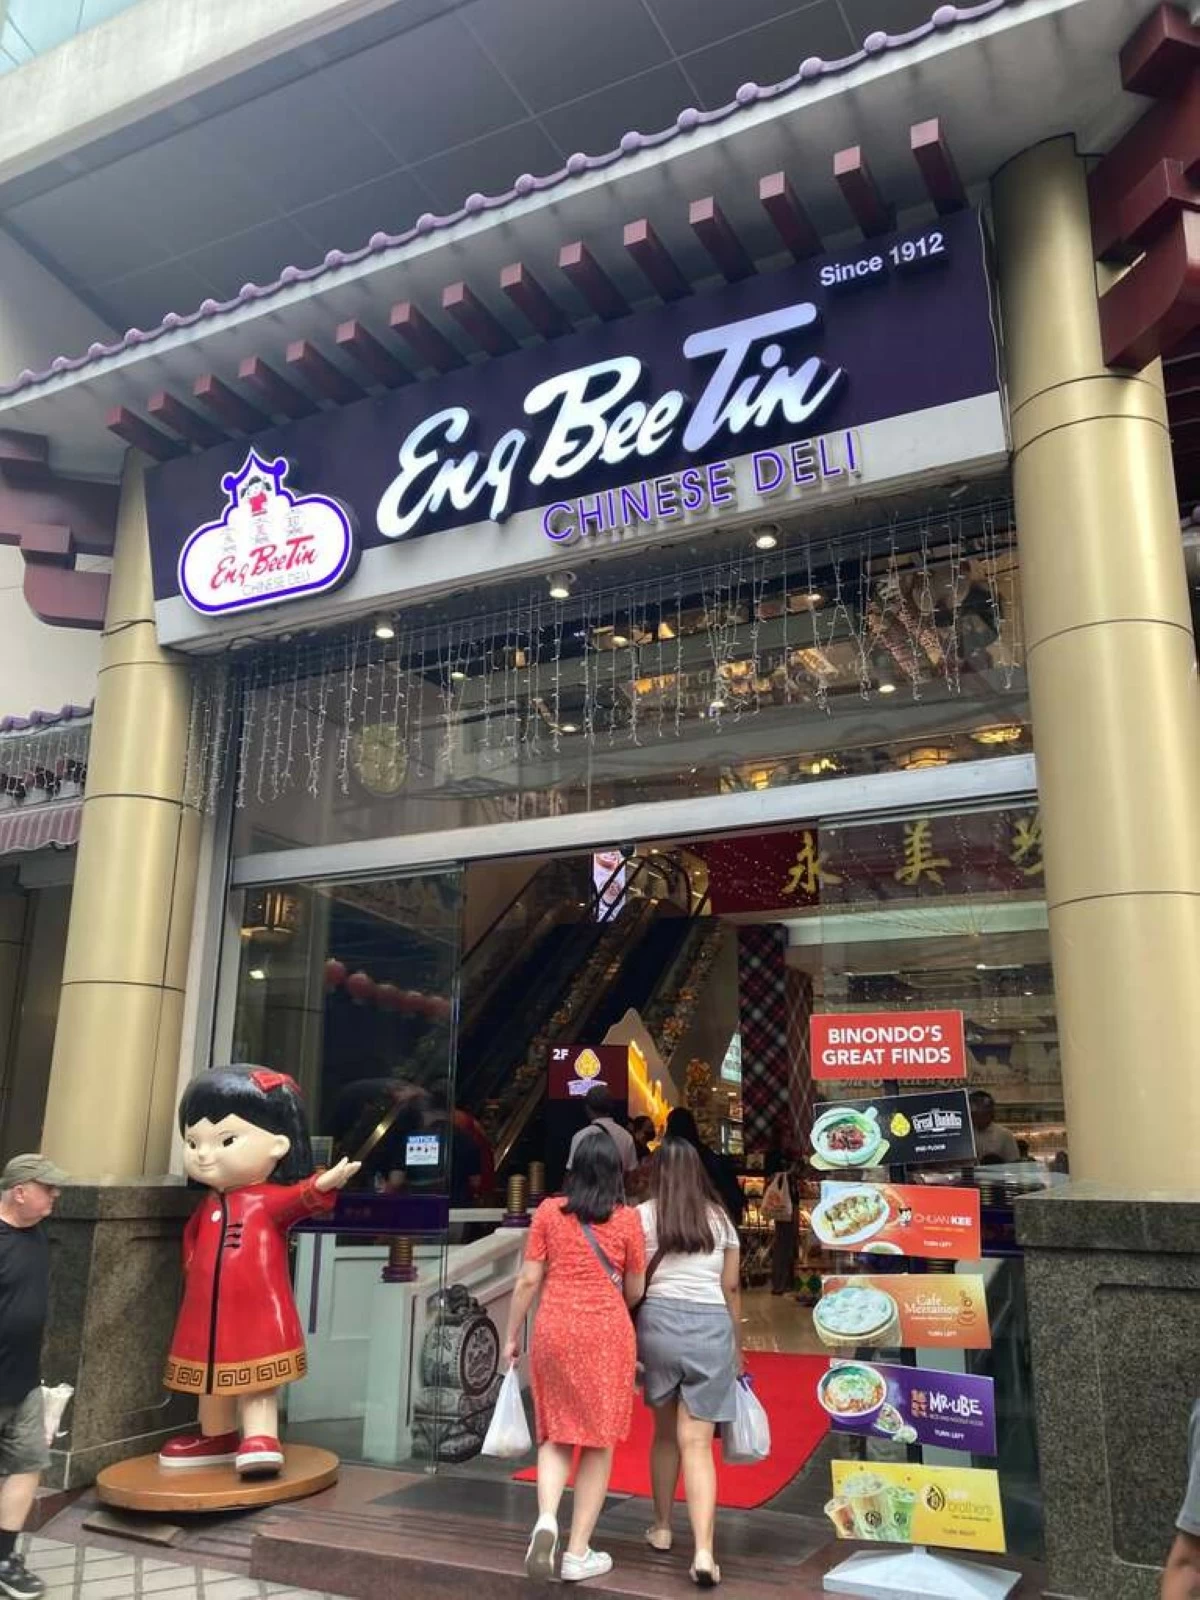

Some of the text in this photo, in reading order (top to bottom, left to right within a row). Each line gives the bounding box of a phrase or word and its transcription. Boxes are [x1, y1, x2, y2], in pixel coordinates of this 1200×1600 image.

[820, 232, 945, 286] Since 1912
[523, 355, 684, 485] Bee
[682, 301, 842, 453] Tin
[540, 431, 858, 542] CHINESE DELI
[249, 544, 288, 577] Bee
[285, 534, 317, 571] Tin
[553, 1048, 569, 1060] 2F
[822, 1046, 951, 1066] GREAT FINDS
[828, 1025, 942, 1045] BINONDO'S
